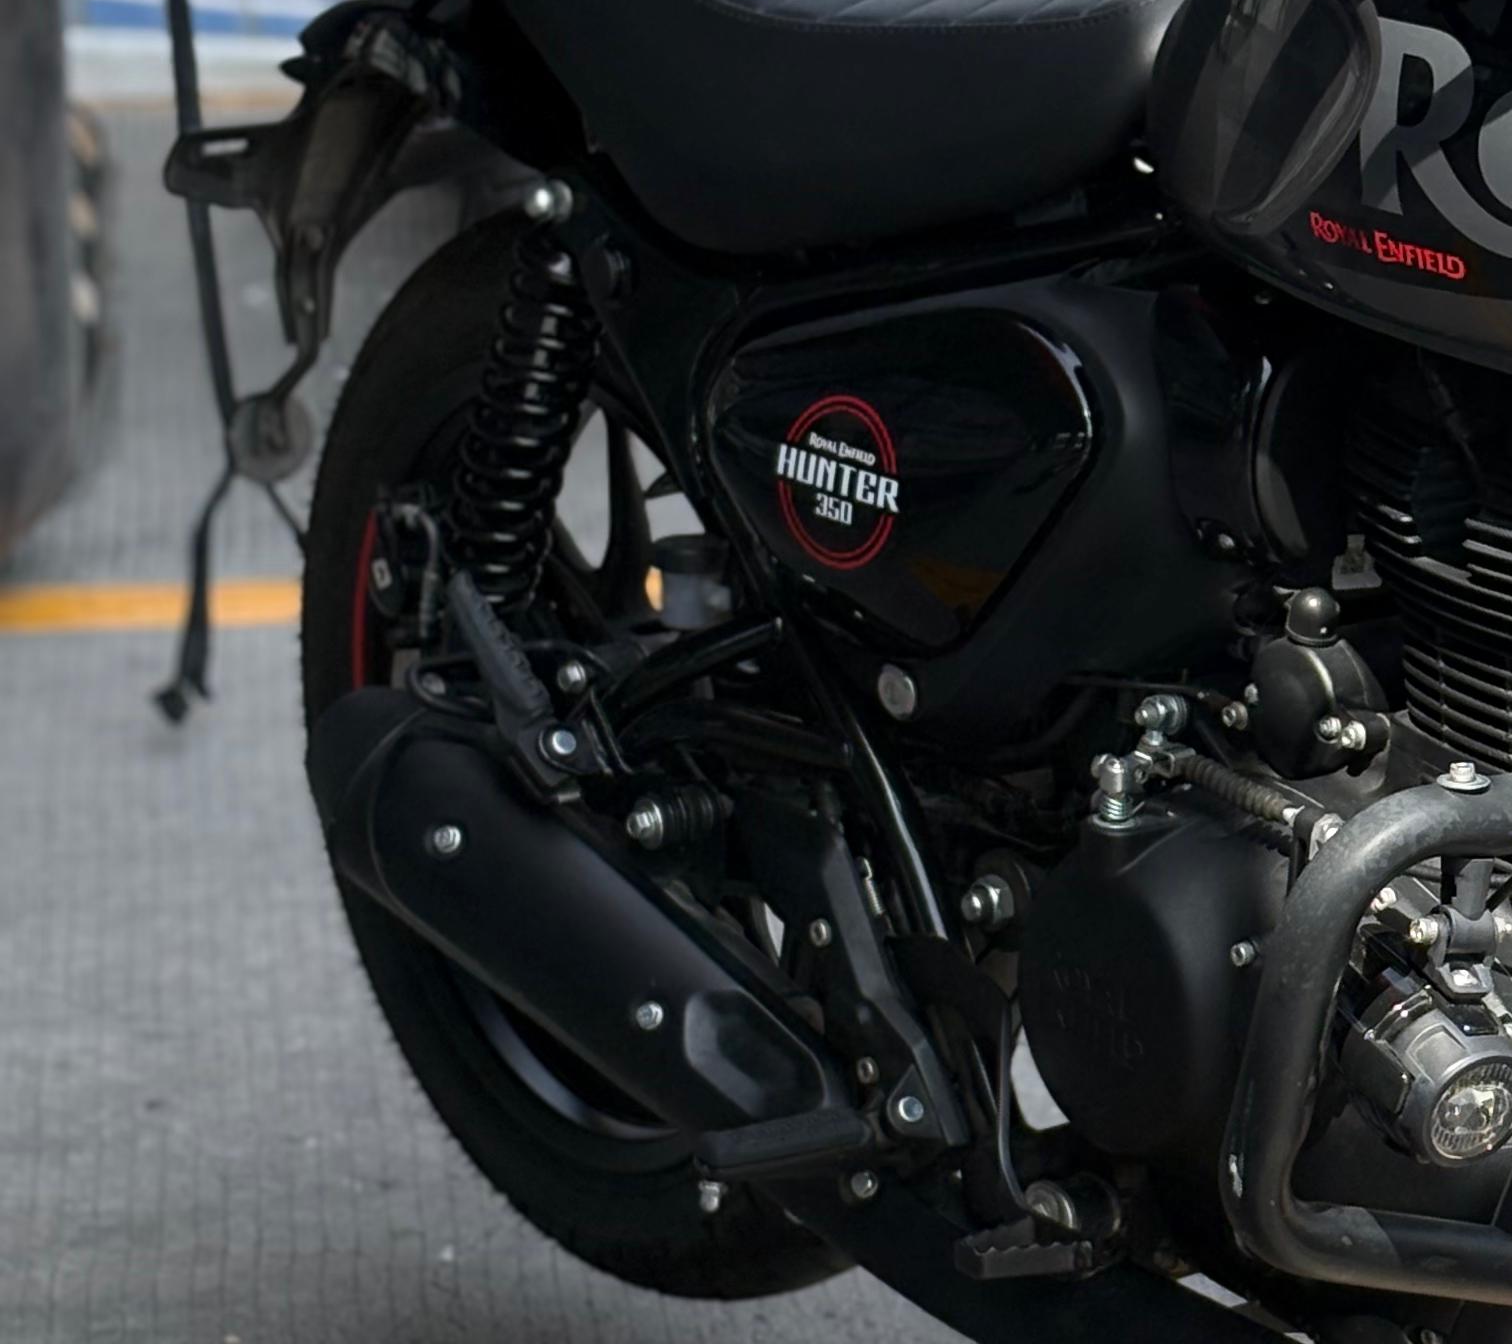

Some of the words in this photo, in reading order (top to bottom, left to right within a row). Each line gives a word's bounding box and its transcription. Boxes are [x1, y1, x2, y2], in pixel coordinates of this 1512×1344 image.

[1373, 230, 1467, 280] ENFIELD
[809, 431, 837, 453] ROYAL
[838, 441, 876, 466] ENFIELD
[777, 443, 900, 513] HUNTER
[815, 493, 853, 526] 350
